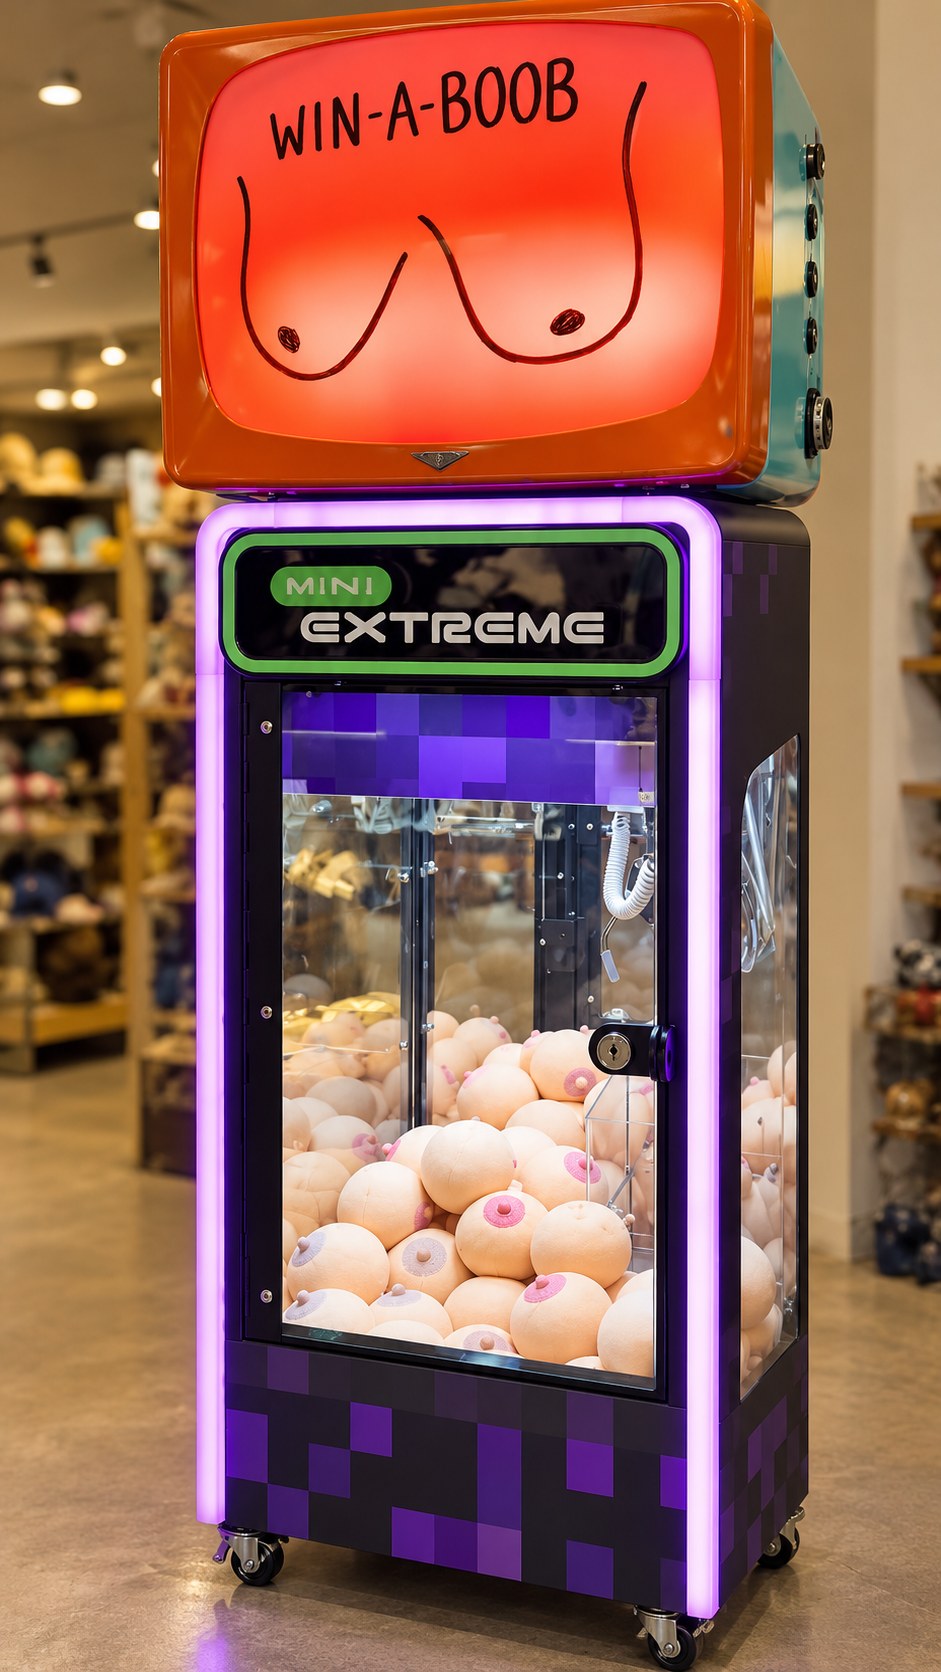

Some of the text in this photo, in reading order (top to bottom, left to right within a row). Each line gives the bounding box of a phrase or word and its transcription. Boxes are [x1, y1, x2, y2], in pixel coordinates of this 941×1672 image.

[271, 57, 578, 160] WIN-A-BOOB
[286, 577, 373, 596] MINI
[300, 611, 605, 644] EXTREME
